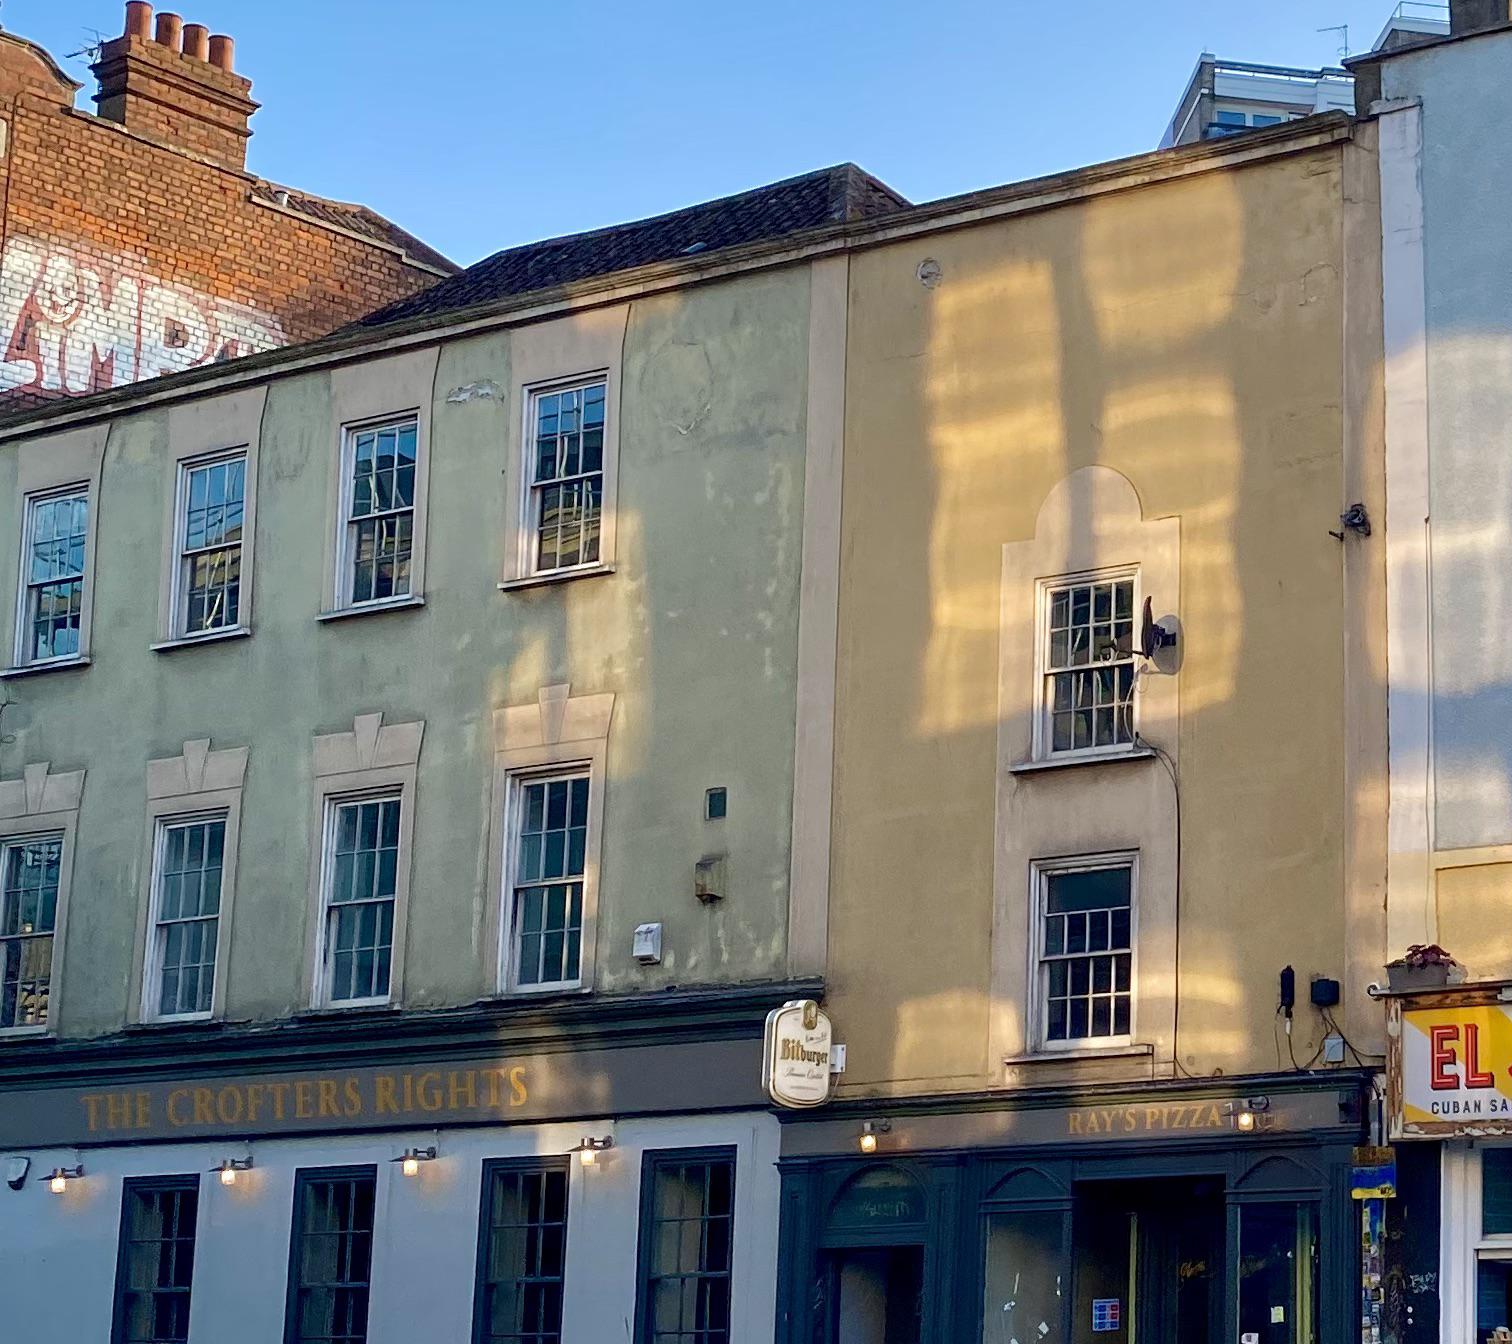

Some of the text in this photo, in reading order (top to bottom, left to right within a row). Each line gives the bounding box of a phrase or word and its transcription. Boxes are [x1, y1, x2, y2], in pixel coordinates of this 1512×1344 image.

[780, 1038, 828, 1066] Bitburger
[1430, 1023, 1494, 1090] EL
[80, 1066, 528, 1131] THE CROFTERS RIGHTS
[1431, 1099, 1481, 1115] CUBAN
[1068, 1108, 1136, 1134] RAY'S
[1145, 1103, 1223, 1130] PIZZA
